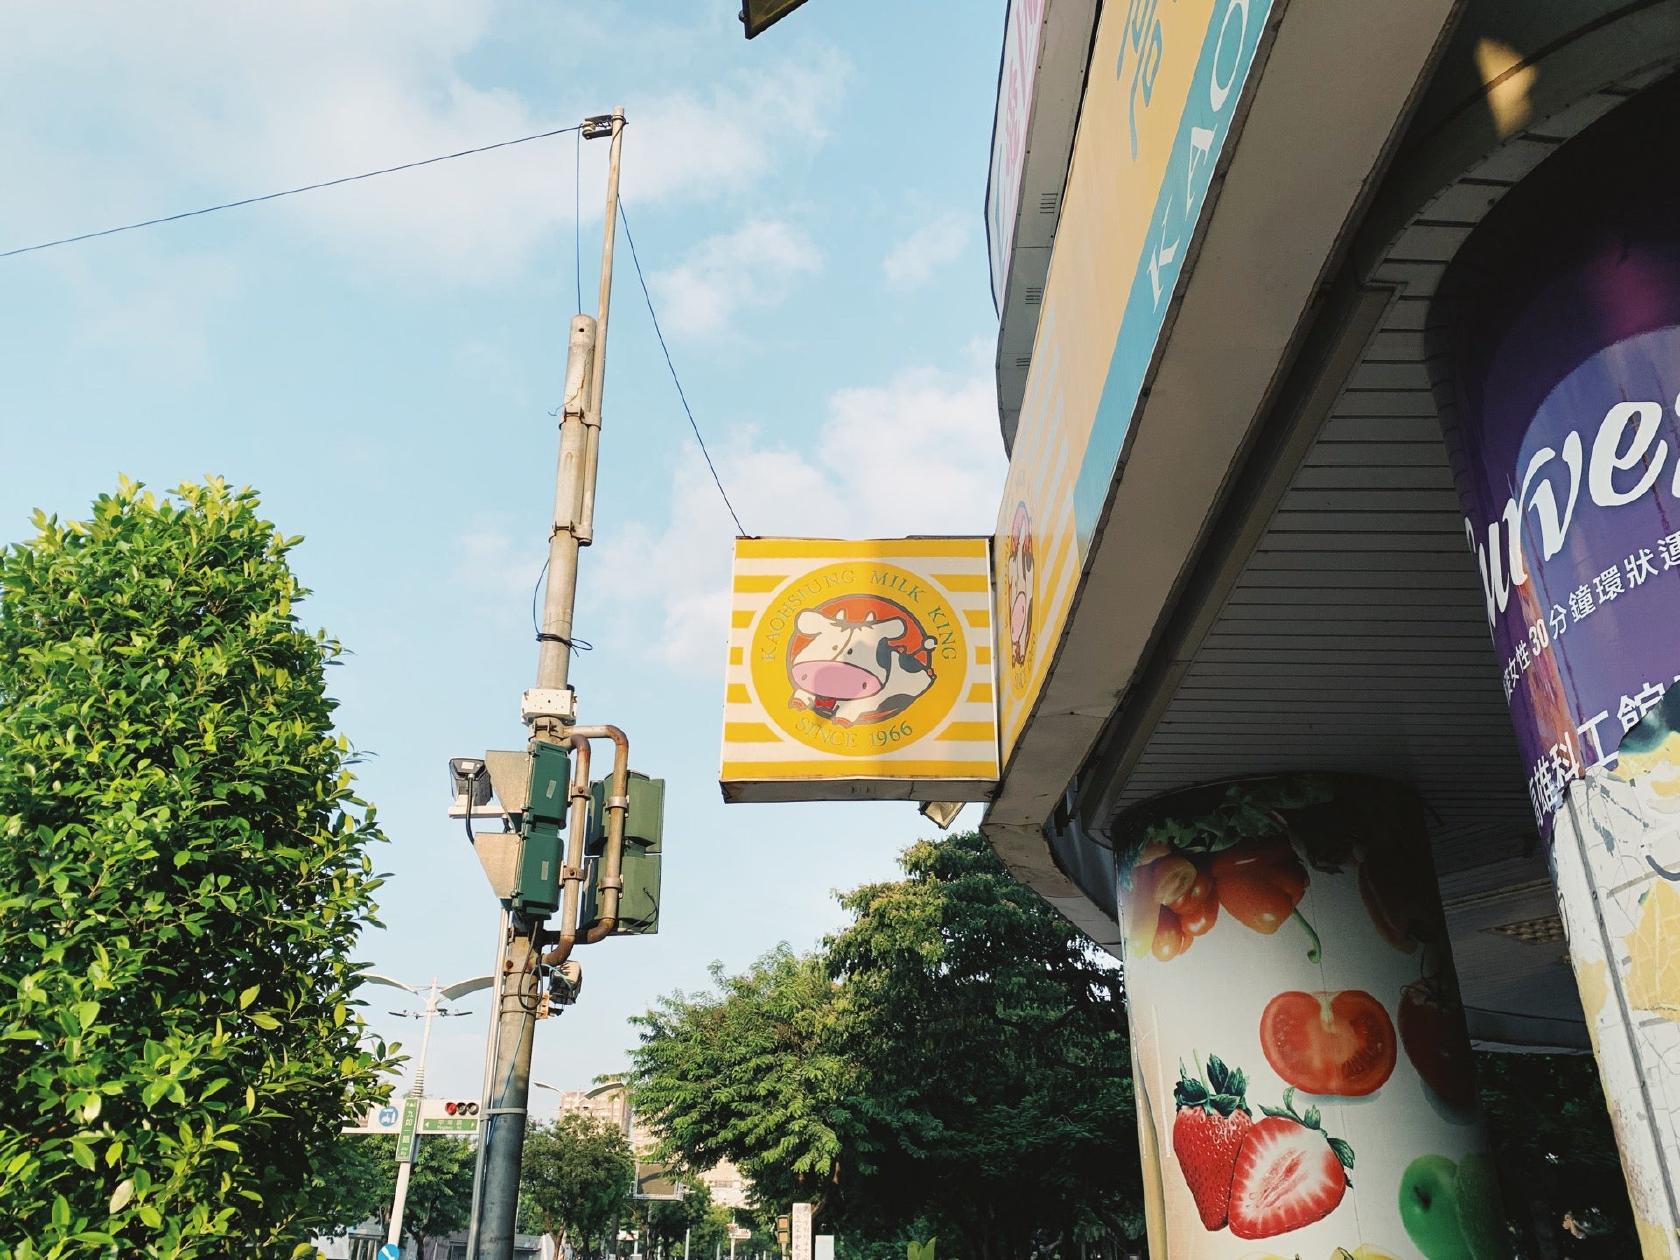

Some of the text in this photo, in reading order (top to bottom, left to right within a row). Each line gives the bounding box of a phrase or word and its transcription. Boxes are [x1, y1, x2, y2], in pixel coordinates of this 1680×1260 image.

[761, 570, 957, 662] KAOHSIUNG MILK KING
[795, 717, 913, 747] SINCE 1966
